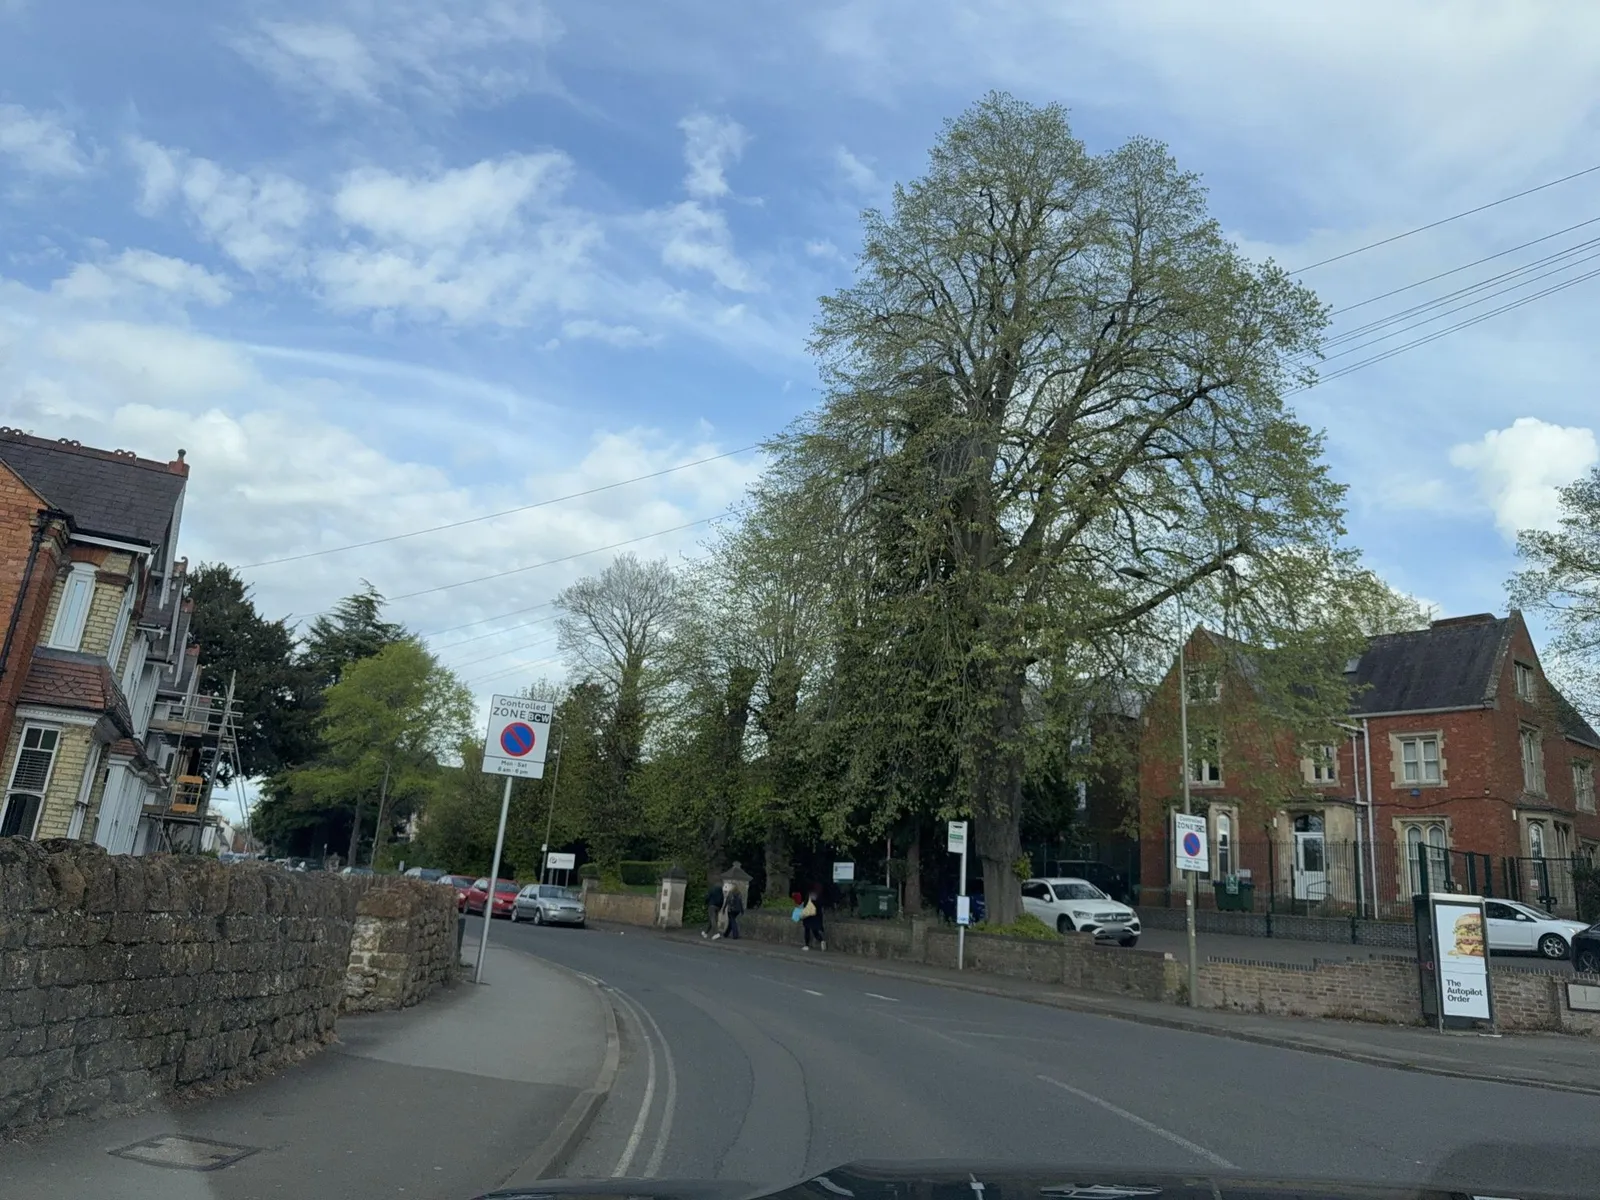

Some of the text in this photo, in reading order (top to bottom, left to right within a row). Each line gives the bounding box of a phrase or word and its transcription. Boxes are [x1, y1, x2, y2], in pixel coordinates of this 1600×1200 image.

[500, 698, 546, 711] Controlled
[493, 707, 550, 723] ZONE BCW
[1177, 821, 1193, 830] ZONE
[1446, 979, 1461, 987] The
[1447, 987, 1483, 996] Autopilot
[1447, 995, 1470, 1003] Order
